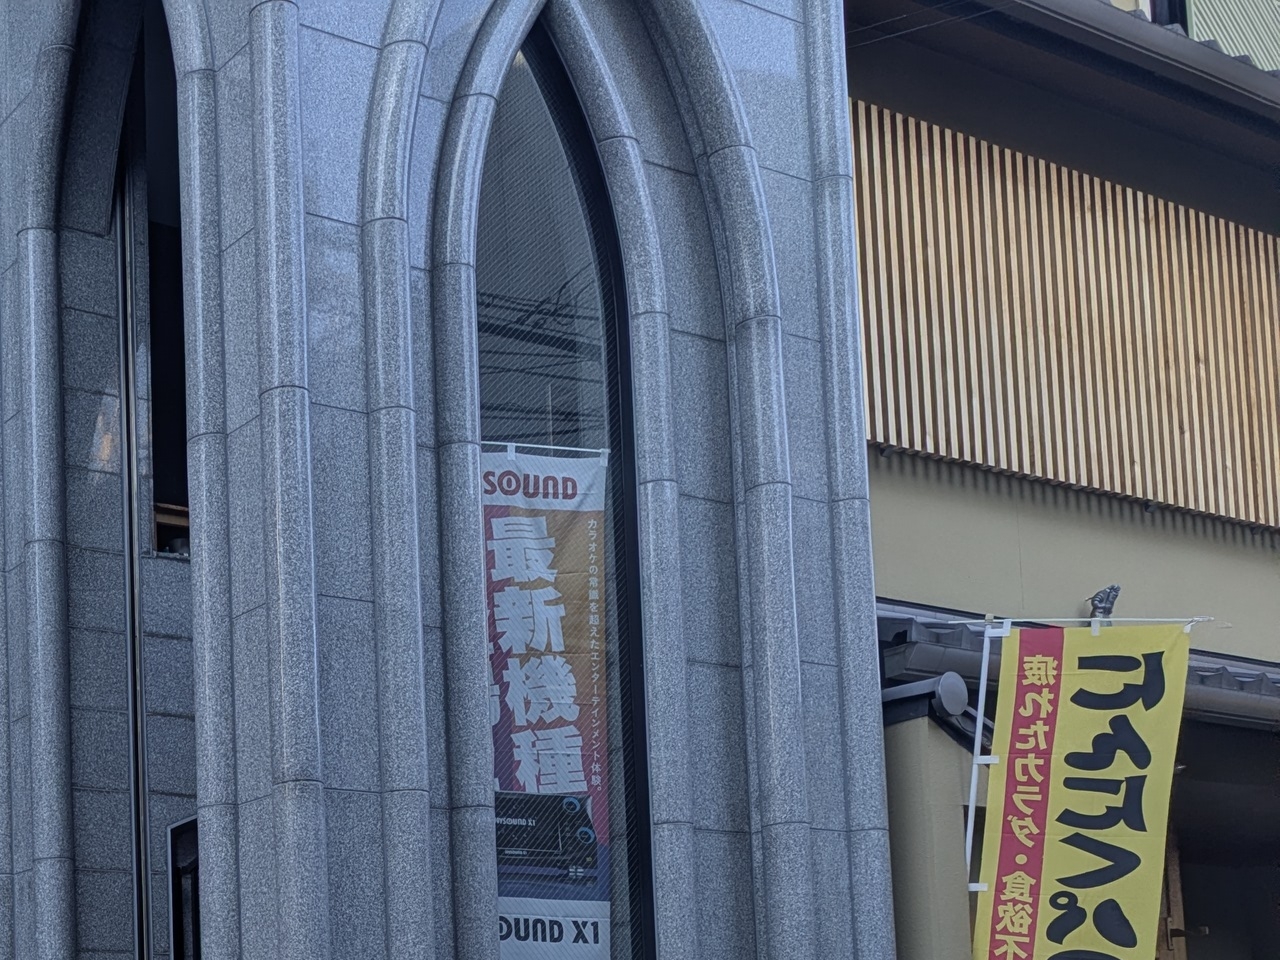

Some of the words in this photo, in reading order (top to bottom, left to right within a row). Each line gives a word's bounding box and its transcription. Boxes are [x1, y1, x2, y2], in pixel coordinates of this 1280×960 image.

[483, 470, 578, 500] SOUND
[487, 516, 588, 794] 最新機種
[587, 519, 603, 792] カラオケの常識を超えたエンターテインメント体験。
[572, 920, 600, 944] X1
